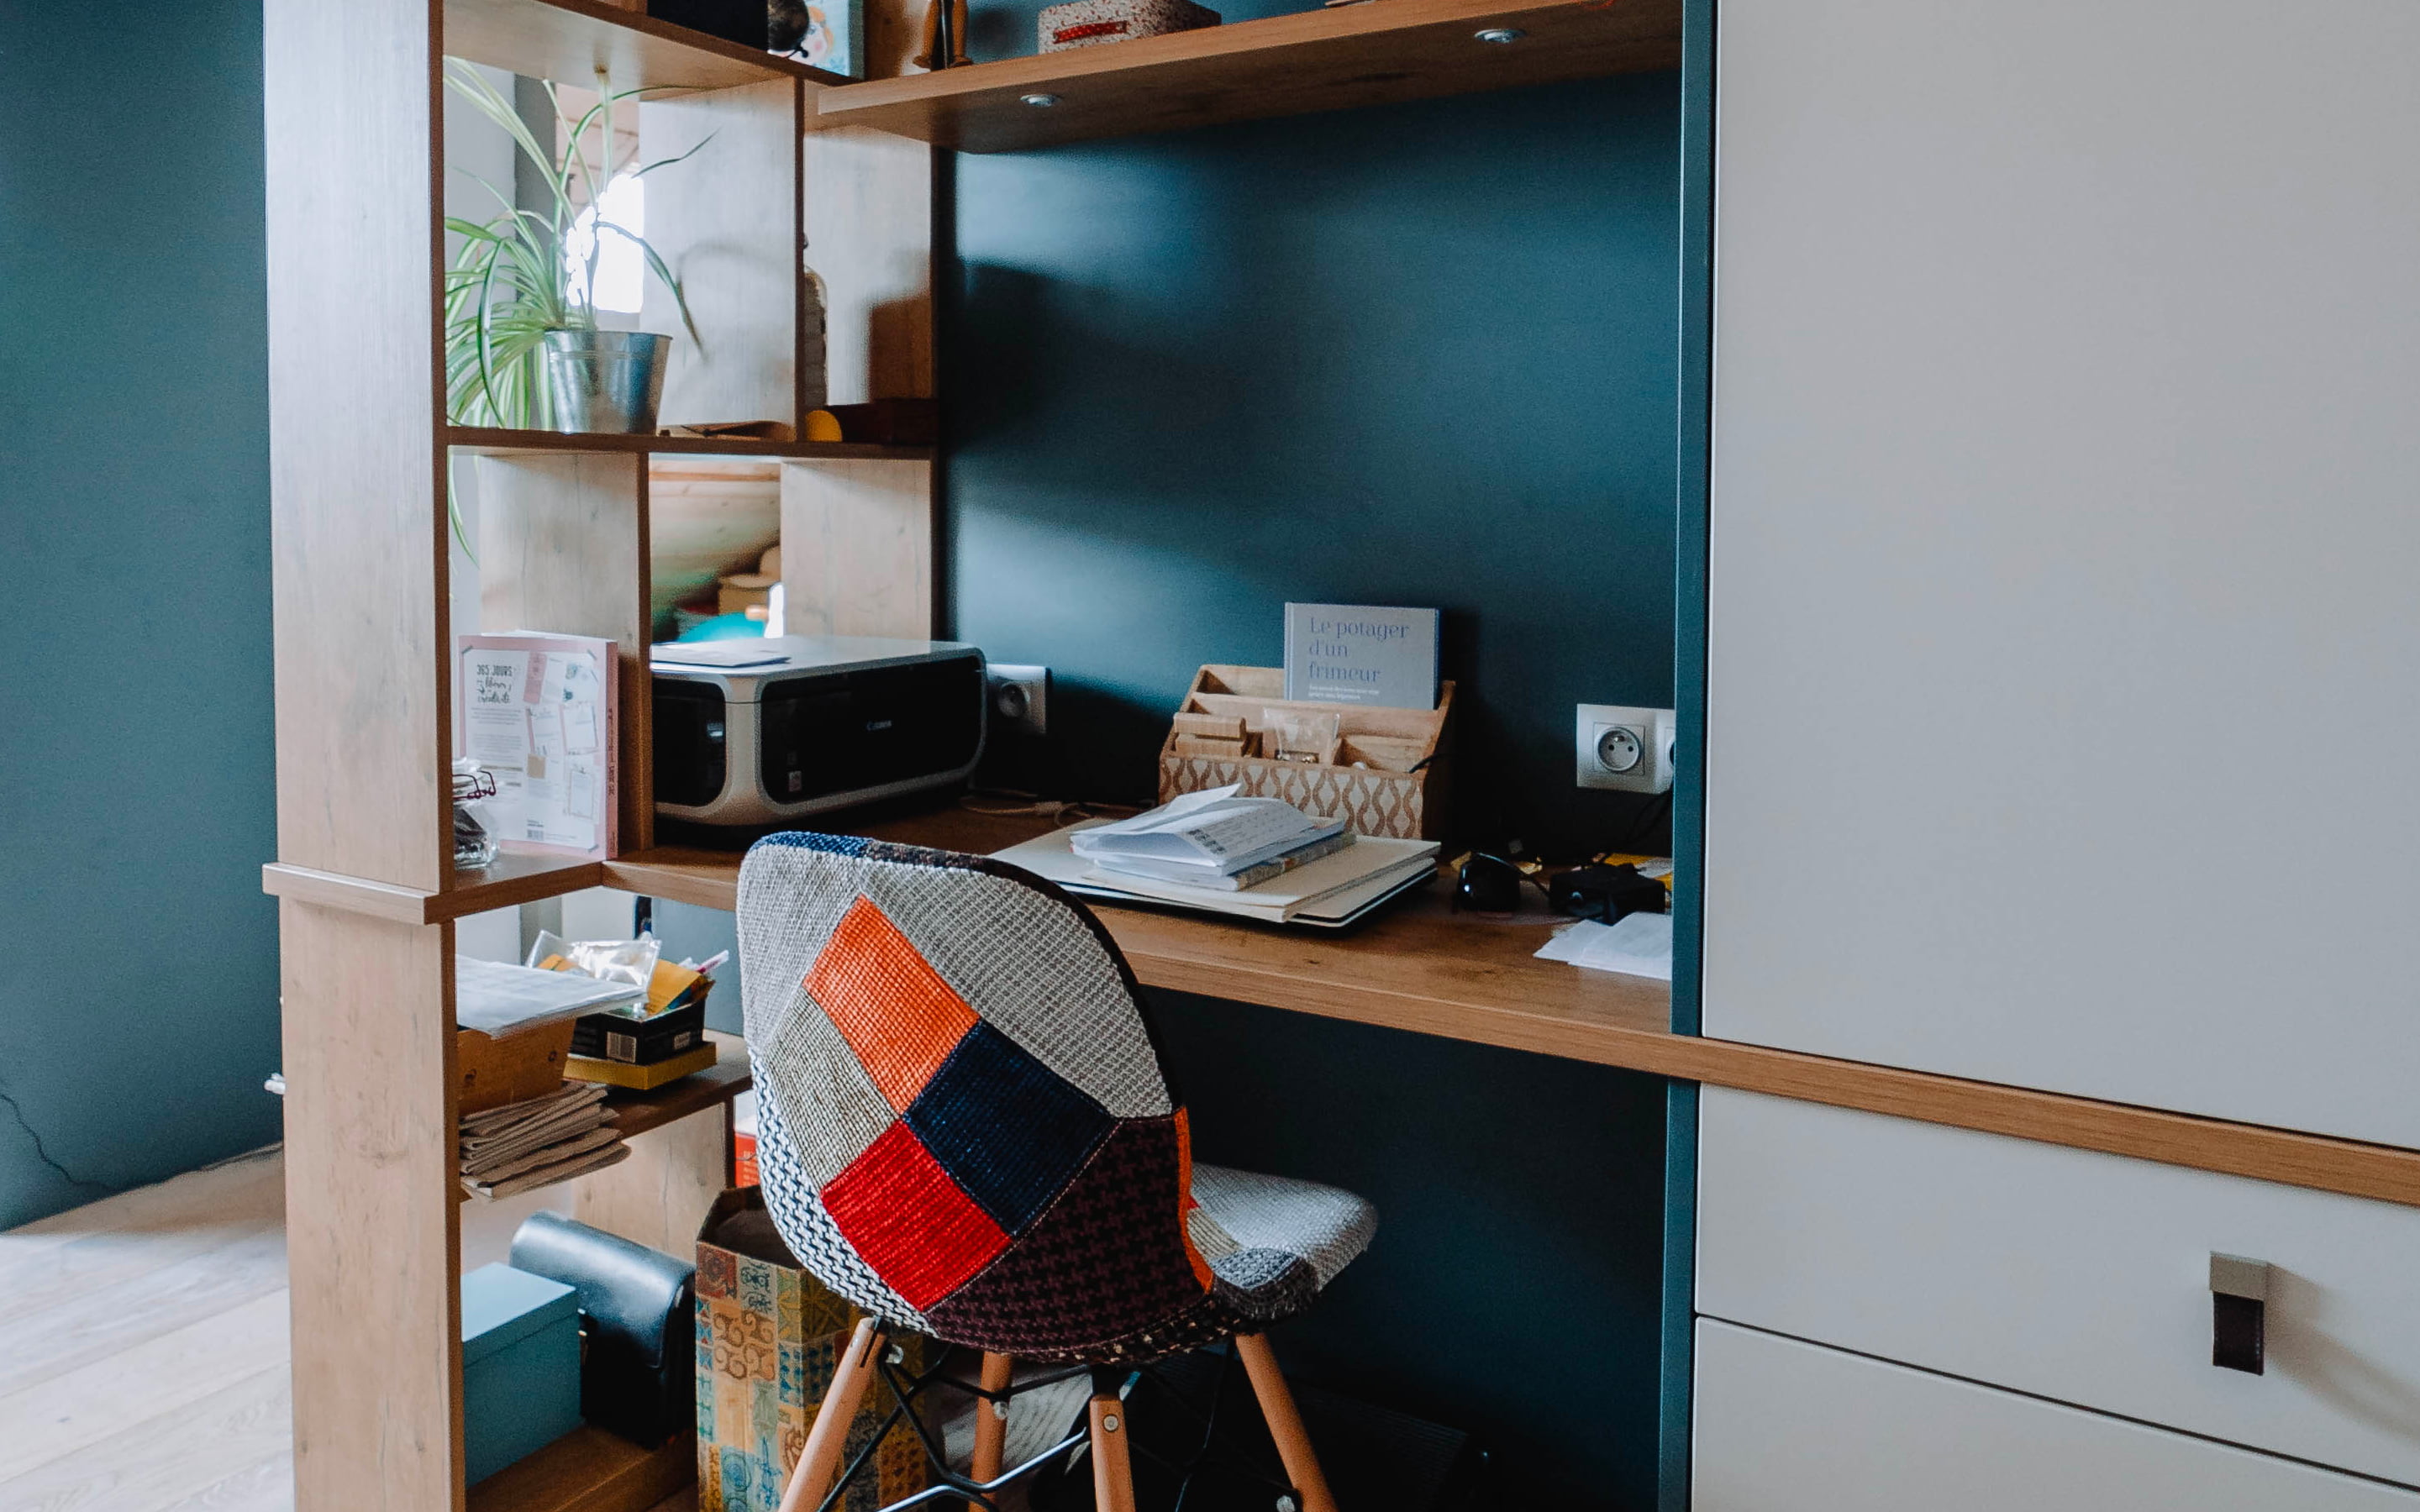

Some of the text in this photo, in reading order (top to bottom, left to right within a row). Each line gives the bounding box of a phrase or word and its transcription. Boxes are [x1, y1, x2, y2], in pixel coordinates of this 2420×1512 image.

[1311, 617, 1410, 642] Le potager
[1309, 638, 1348, 657] d'un
[476, 664, 489, 675] 365
[1308, 660, 1381, 682] frimeur
